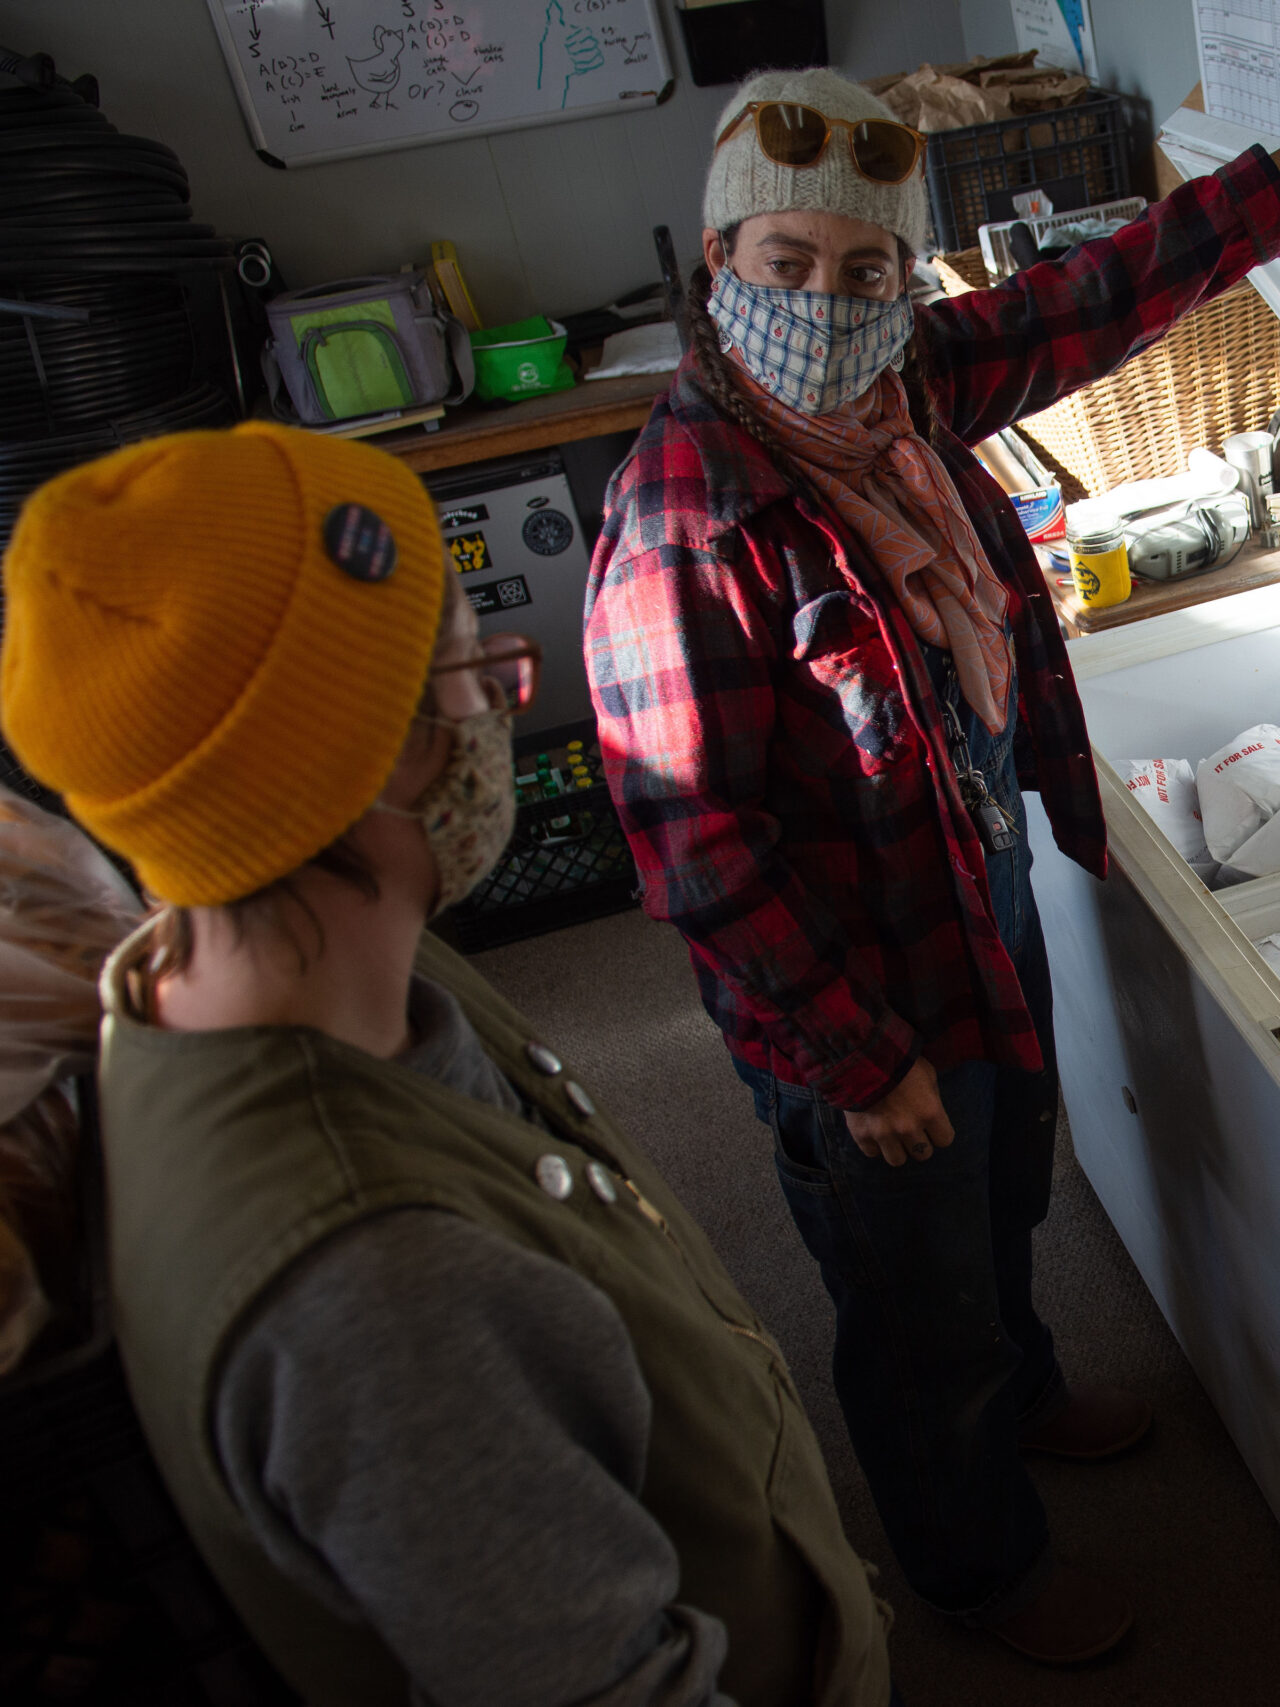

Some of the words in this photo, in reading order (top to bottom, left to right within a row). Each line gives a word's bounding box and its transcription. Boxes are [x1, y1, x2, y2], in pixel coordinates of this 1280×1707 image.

[1222, 752, 1243, 767] FOR
[1241, 742, 1265, 756] SALE
[1156, 769, 1167, 787] FOR
[1156, 787, 1170, 804] NOT
